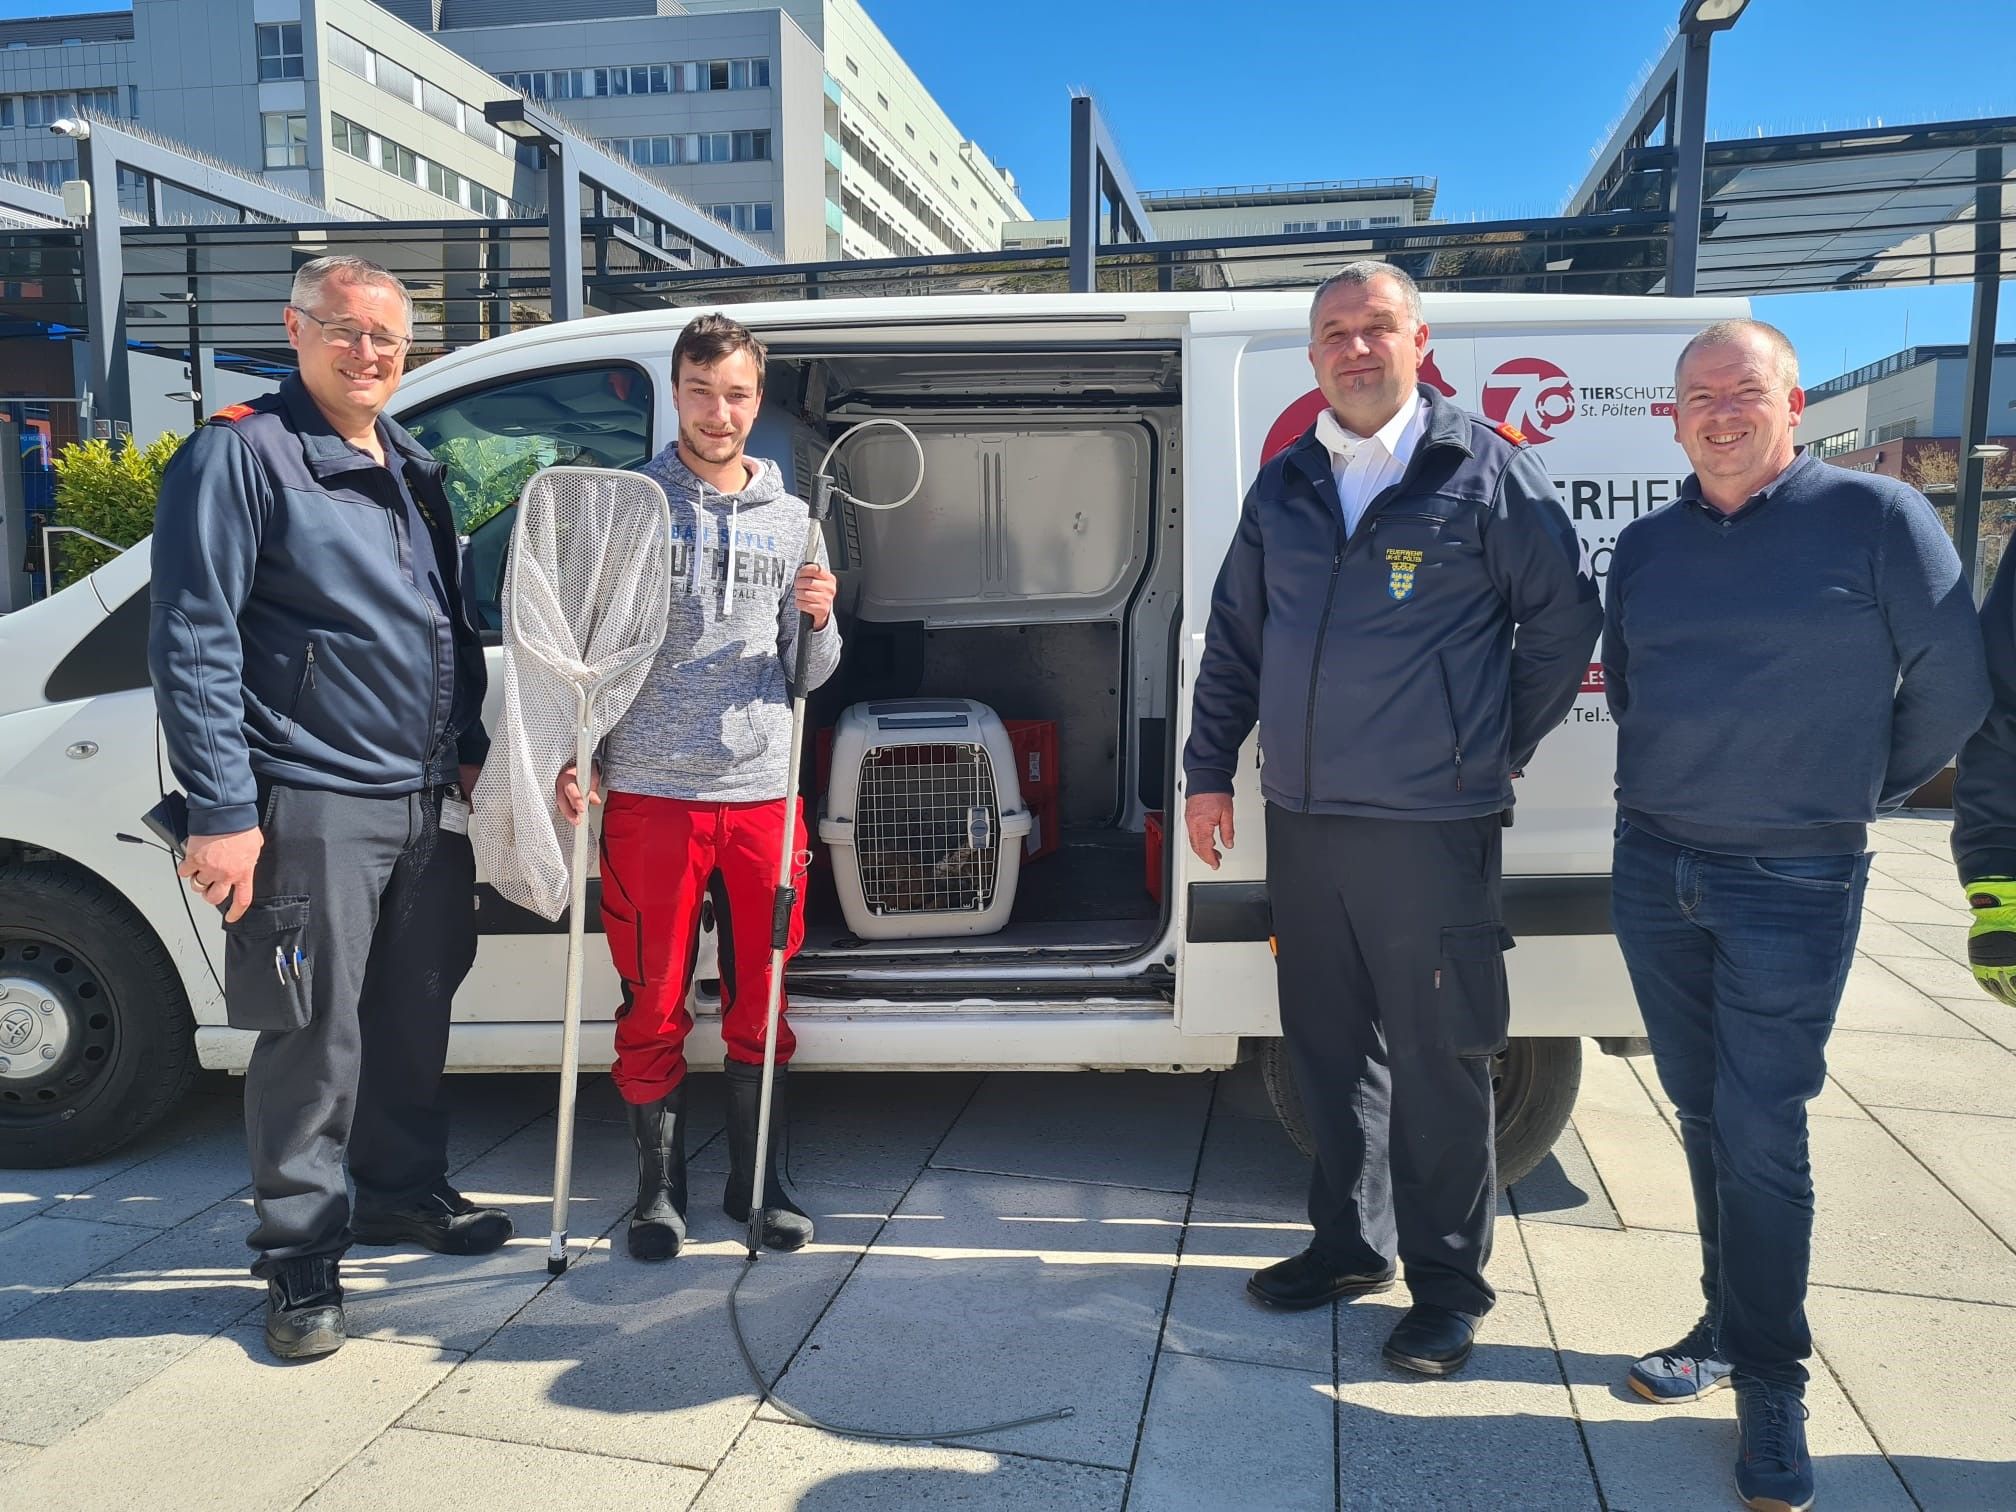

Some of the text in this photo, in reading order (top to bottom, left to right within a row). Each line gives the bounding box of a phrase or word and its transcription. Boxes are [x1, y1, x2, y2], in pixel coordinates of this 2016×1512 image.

[1580, 386, 1677, 400] TIERSCHUTZ
[1580, 402, 1647, 417] St. Pölten
[1572, 706, 1610, 722] Tel.:
